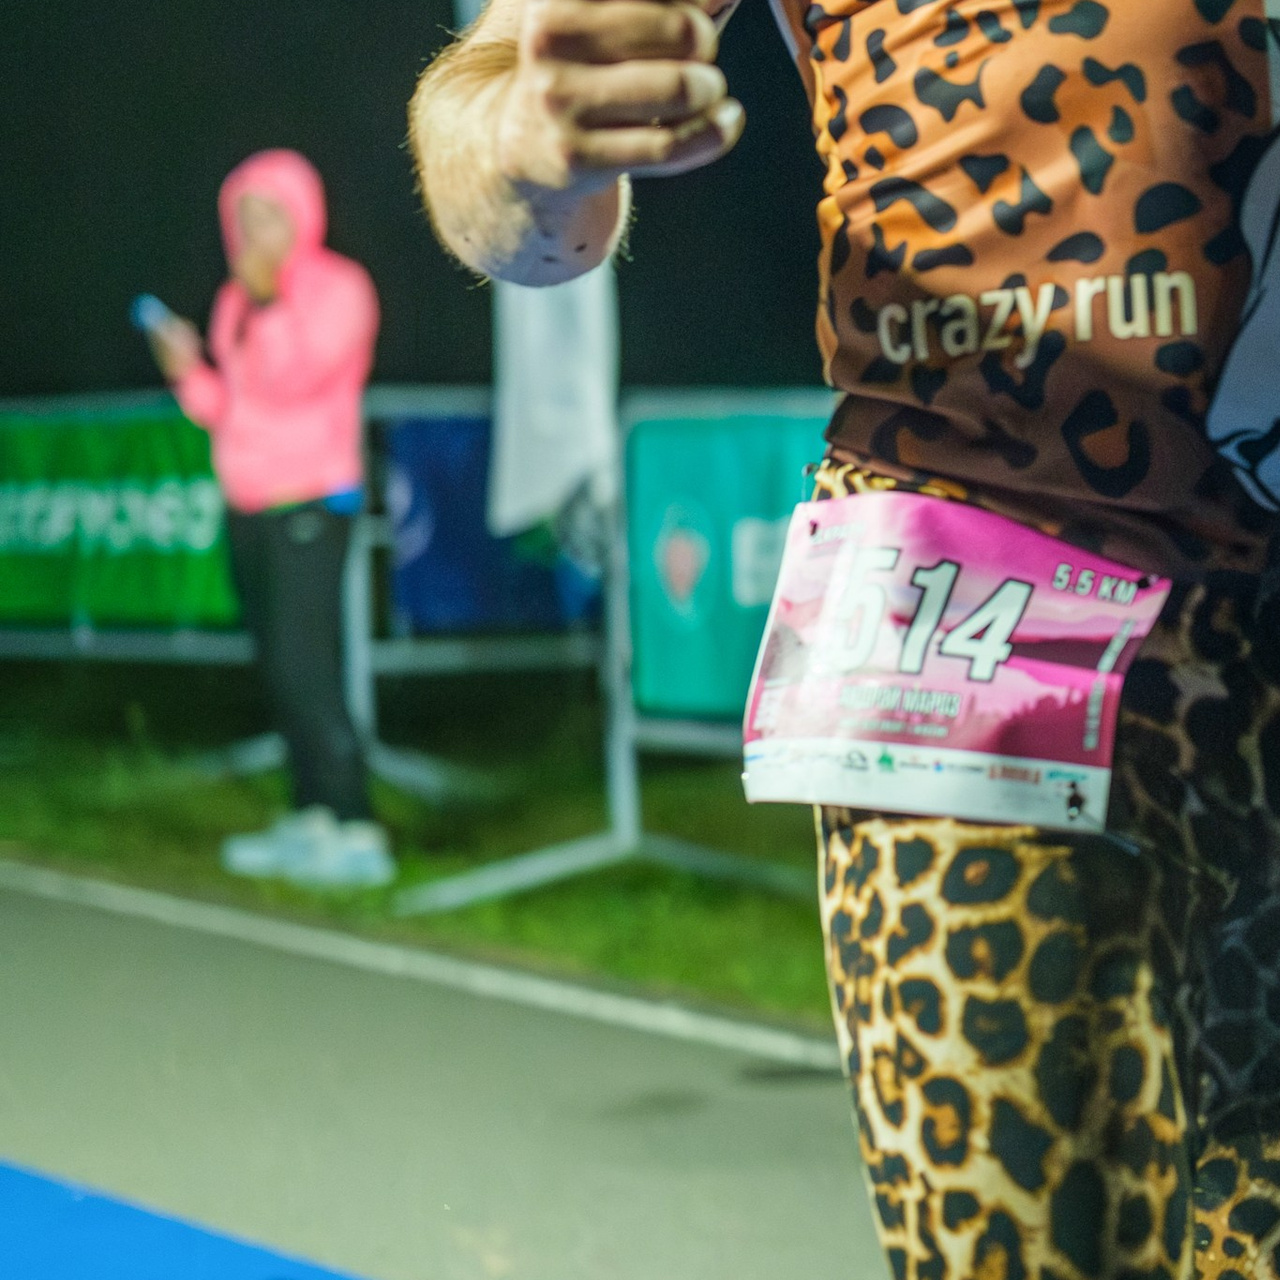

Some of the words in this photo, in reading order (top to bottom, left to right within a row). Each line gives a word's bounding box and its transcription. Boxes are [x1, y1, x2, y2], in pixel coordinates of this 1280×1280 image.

[876, 282, 1056, 369] crazy
[1075, 270, 1199, 342] run
[822, 547, 1035, 682] 514
[1052, 563, 1095, 596] 5.5
